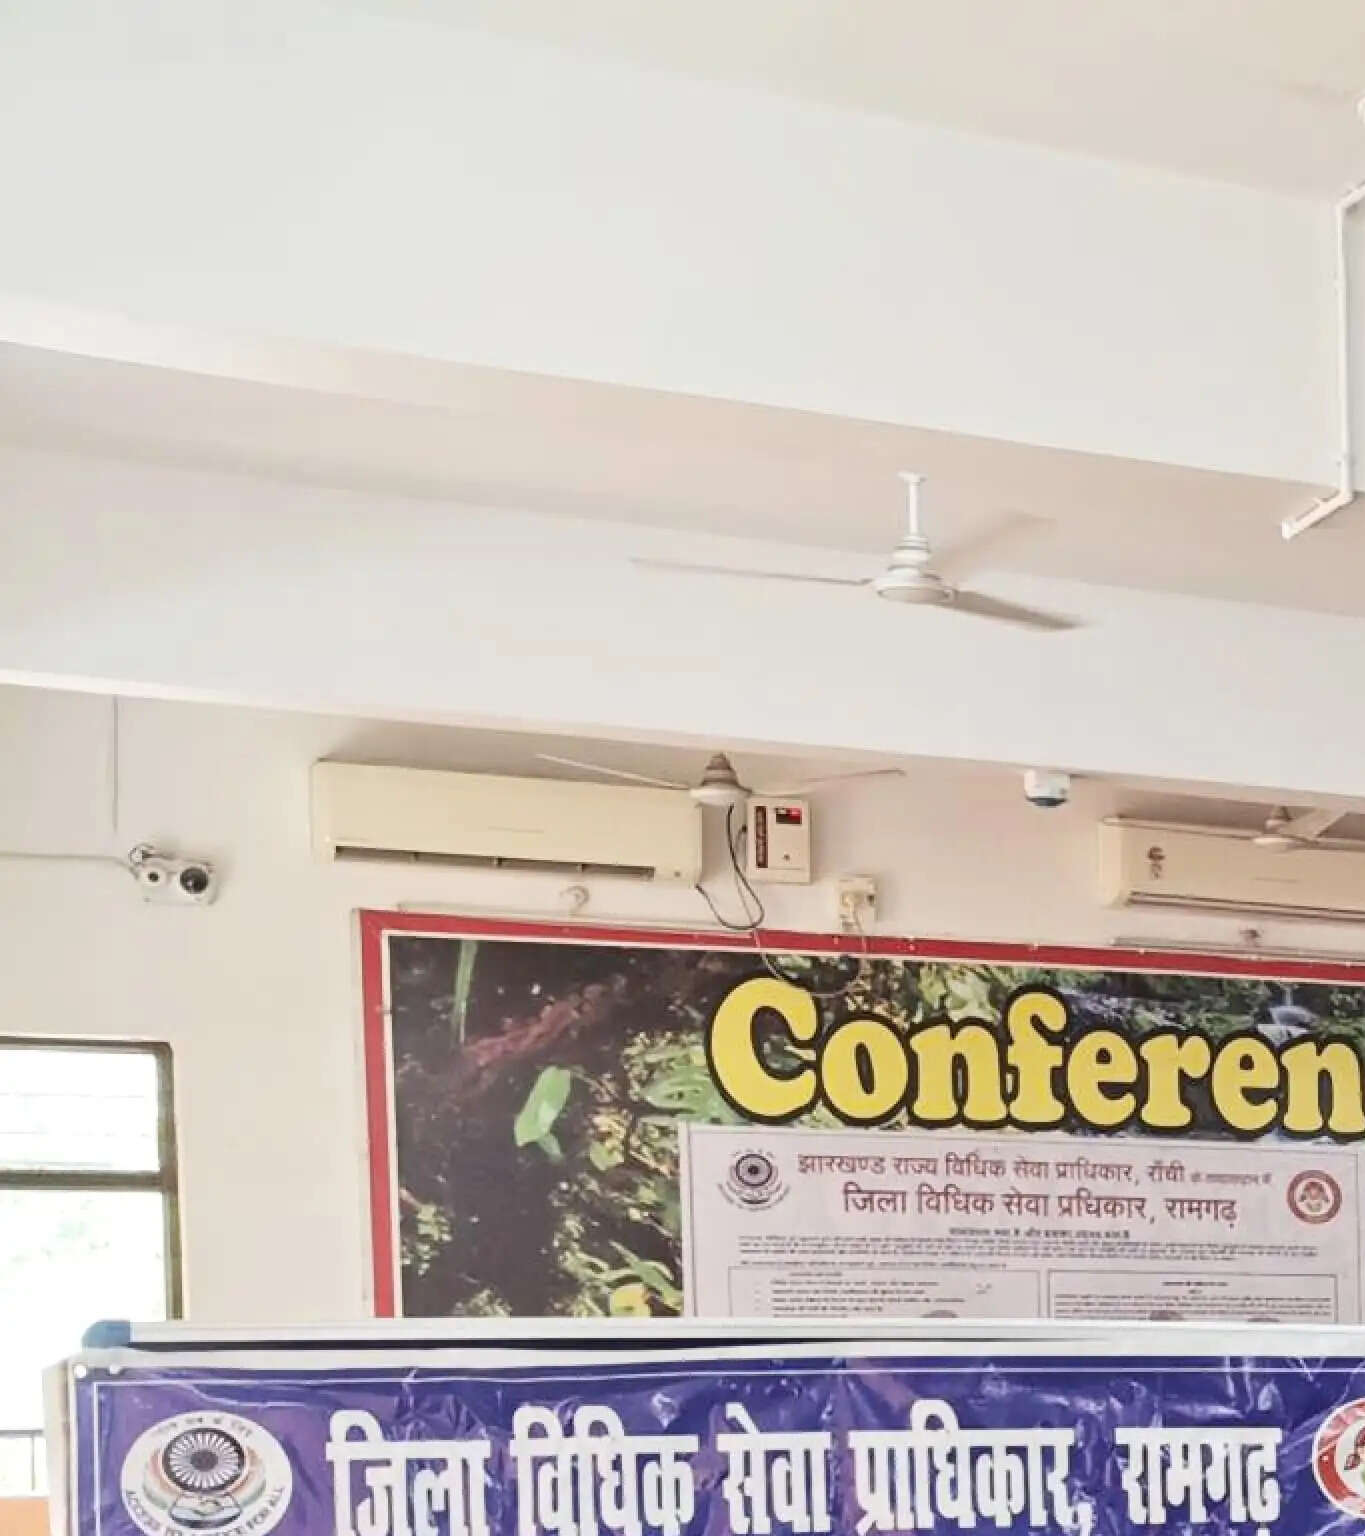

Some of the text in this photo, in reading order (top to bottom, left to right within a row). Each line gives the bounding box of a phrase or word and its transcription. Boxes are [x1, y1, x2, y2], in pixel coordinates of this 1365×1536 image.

[796, 1153, 885, 1175] झारखण्ड
[891, 1155, 939, 1177] राज्य
[944, 1150, 1006, 1178] विधिक
[1012, 1154, 1049, 1180] सेवा
[842, 1180, 907, 1214] जिला
[916, 1181, 995, 1216] विधिक
[1002, 1184, 1049, 1218] सेवा
[1163, 1197, 1239, 1230] रामगढ़
[716, 1402, 833, 1535] सेवा
